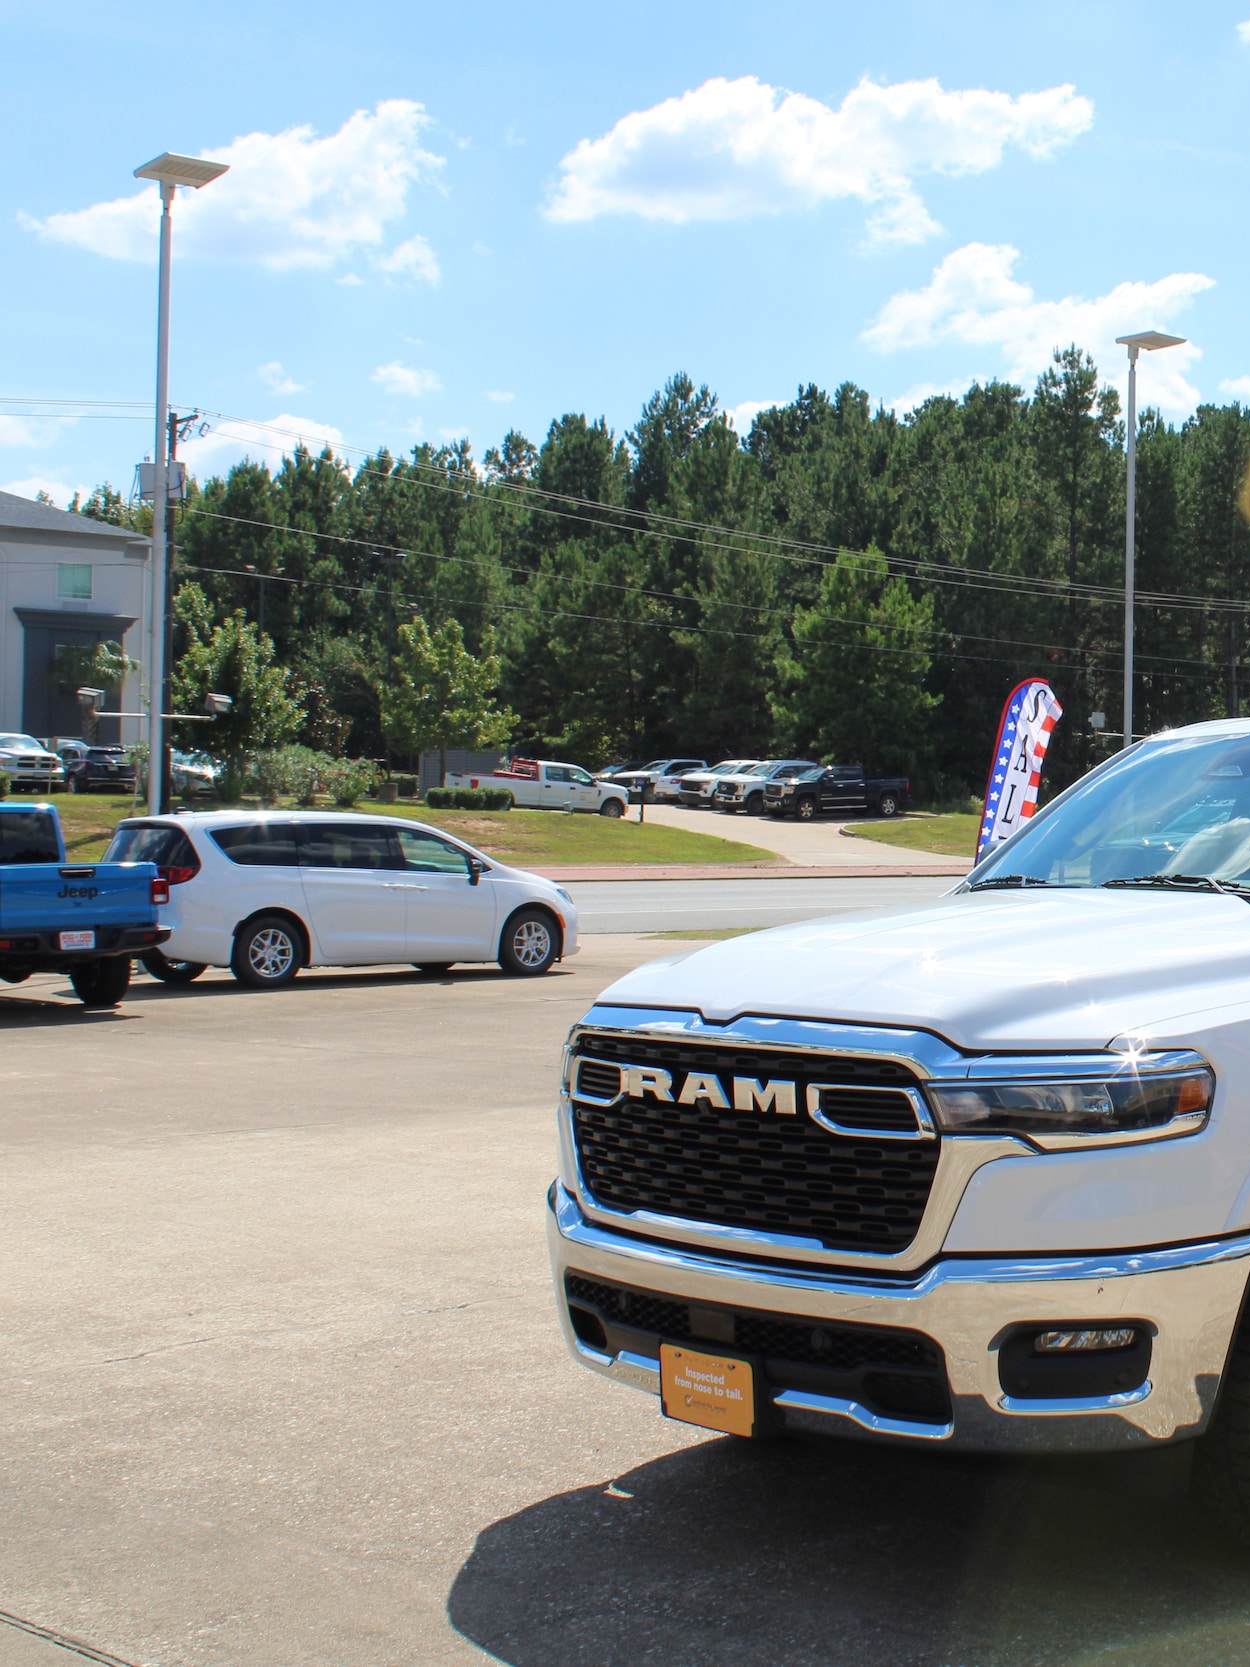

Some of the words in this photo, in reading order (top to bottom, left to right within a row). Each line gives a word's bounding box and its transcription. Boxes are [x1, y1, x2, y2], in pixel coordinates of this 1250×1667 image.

[998, 689, 1047, 839] SAL
[58, 885, 98, 900] Jeep
[626, 1063, 796, 1115] RAM
[674, 1375, 692, 1388] from
[694, 1383, 712, 1394] nose
[714, 1386, 724, 1396] to
[726, 1388, 743, 1400] tail.
[685, 1366, 725, 1385] Inspected
